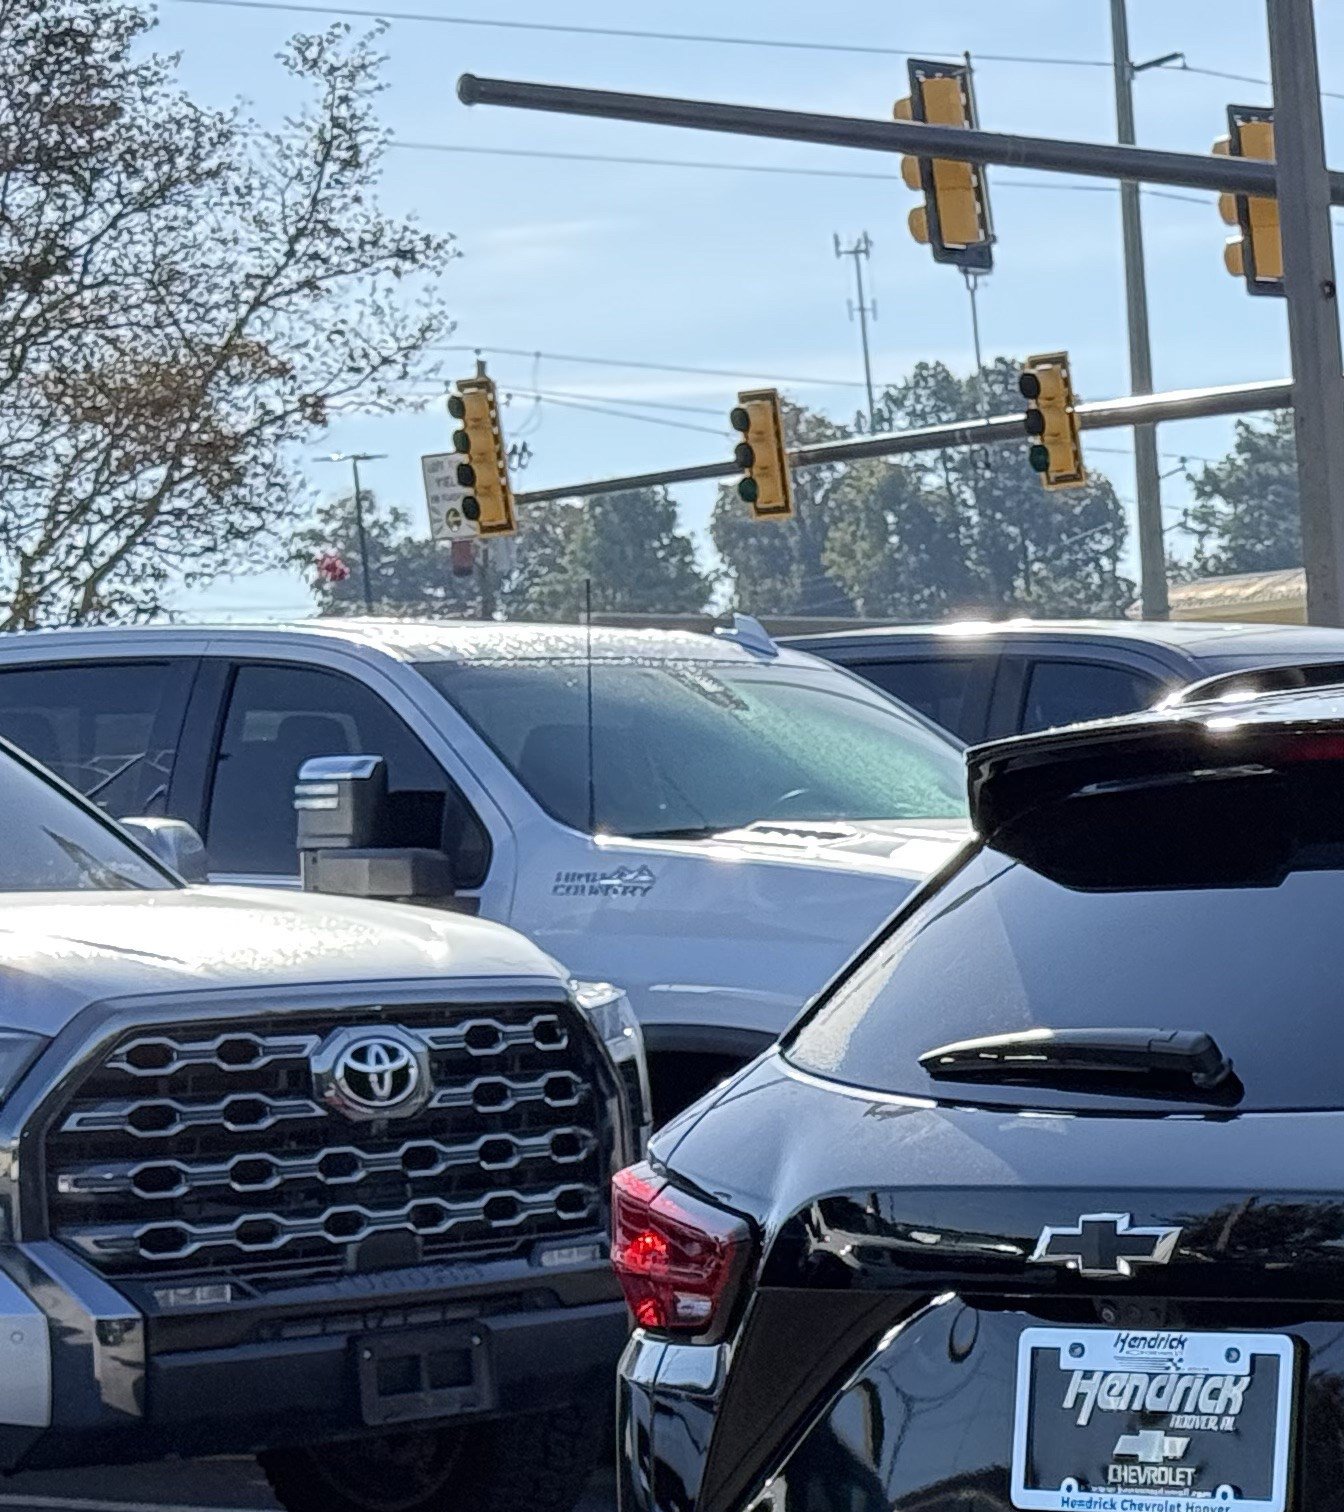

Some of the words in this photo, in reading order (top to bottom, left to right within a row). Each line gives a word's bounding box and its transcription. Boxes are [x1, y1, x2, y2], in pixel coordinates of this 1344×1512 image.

[1113, 1333, 1188, 1353] Hendrick
[1062, 1371, 1250, 1426] Hendrick
[1108, 1464, 1196, 1486] CHEVROLET
[1061, 1497, 1116, 1511] Hendrick
[1120, 1500, 1181, 1512] Chevrolet
